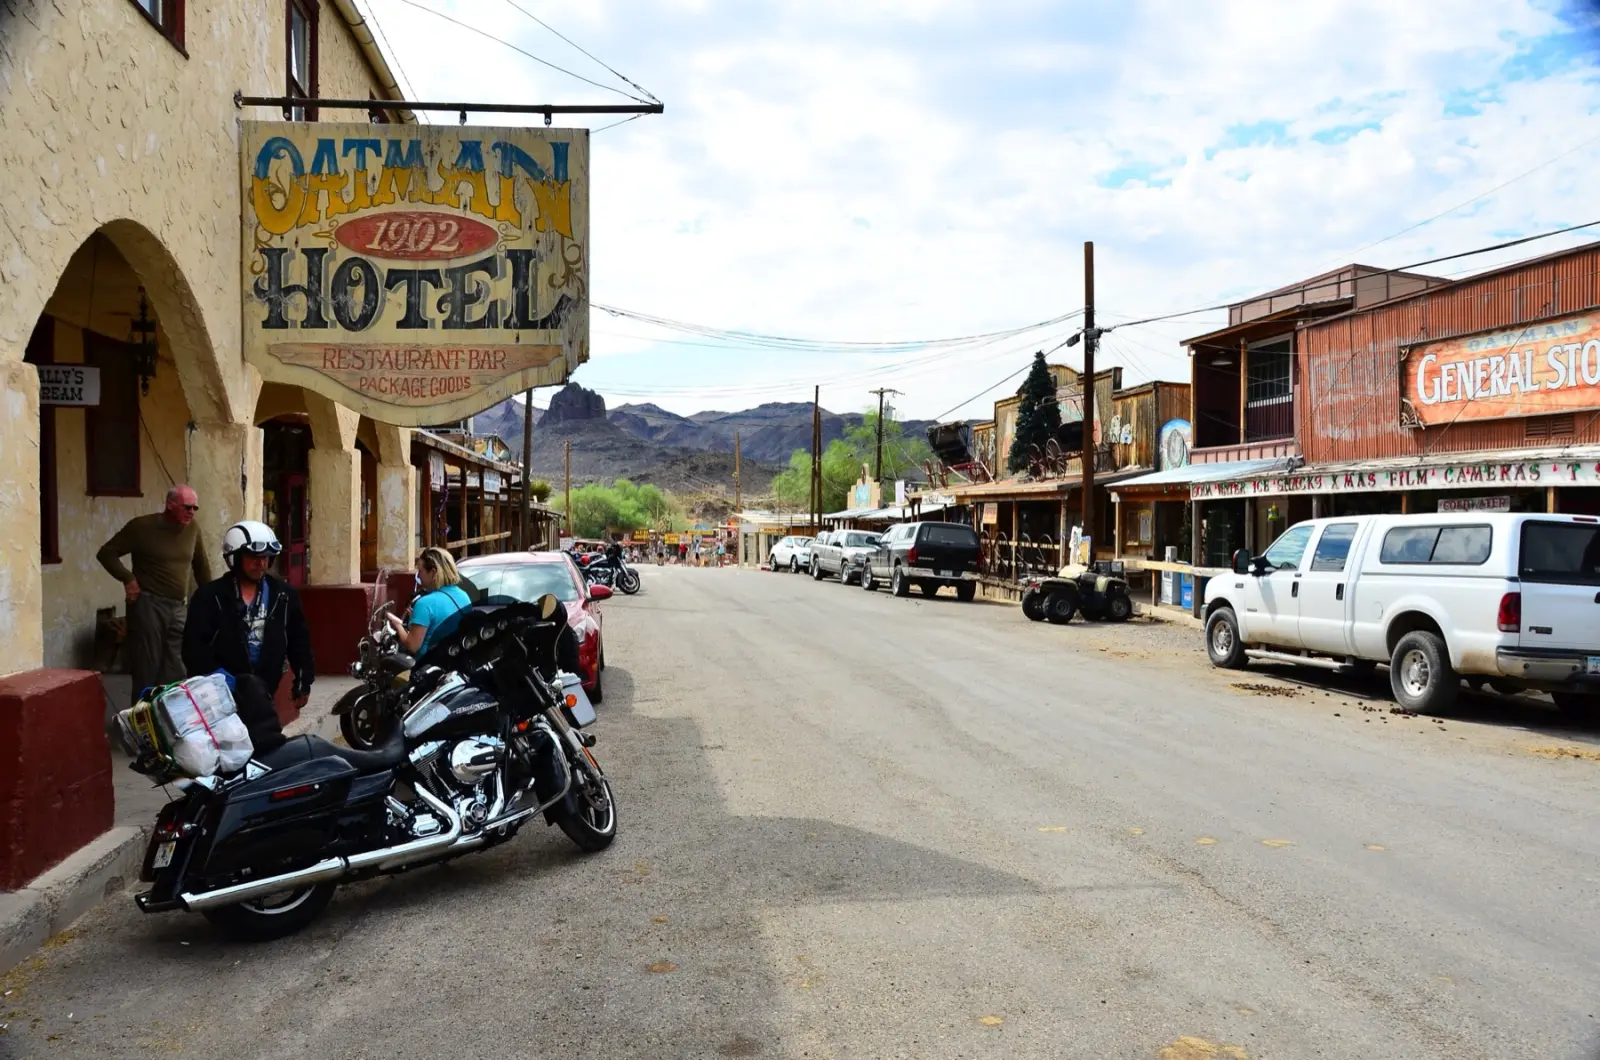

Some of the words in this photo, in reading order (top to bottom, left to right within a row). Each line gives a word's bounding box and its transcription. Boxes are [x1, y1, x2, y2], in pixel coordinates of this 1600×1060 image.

[252, 136, 574, 239] OATMAN
[365, 217, 462, 253] 1902
[253, 247, 575, 332] HOTEL
[1467, 321, 1580, 351] OATMAN
[322, 348, 465, 371] RESTAURANT
[467, 348, 508, 370] BAR
[359, 376, 428, 399] PACKAGE
[430, 376, 473, 398] GOODS
[1416, 350, 1541, 406] GENERAL
[1252, 480, 1270, 494] ICE
[1389, 468, 1428, 487] FILM
[1444, 463, 1541, 484] CAMERAS
